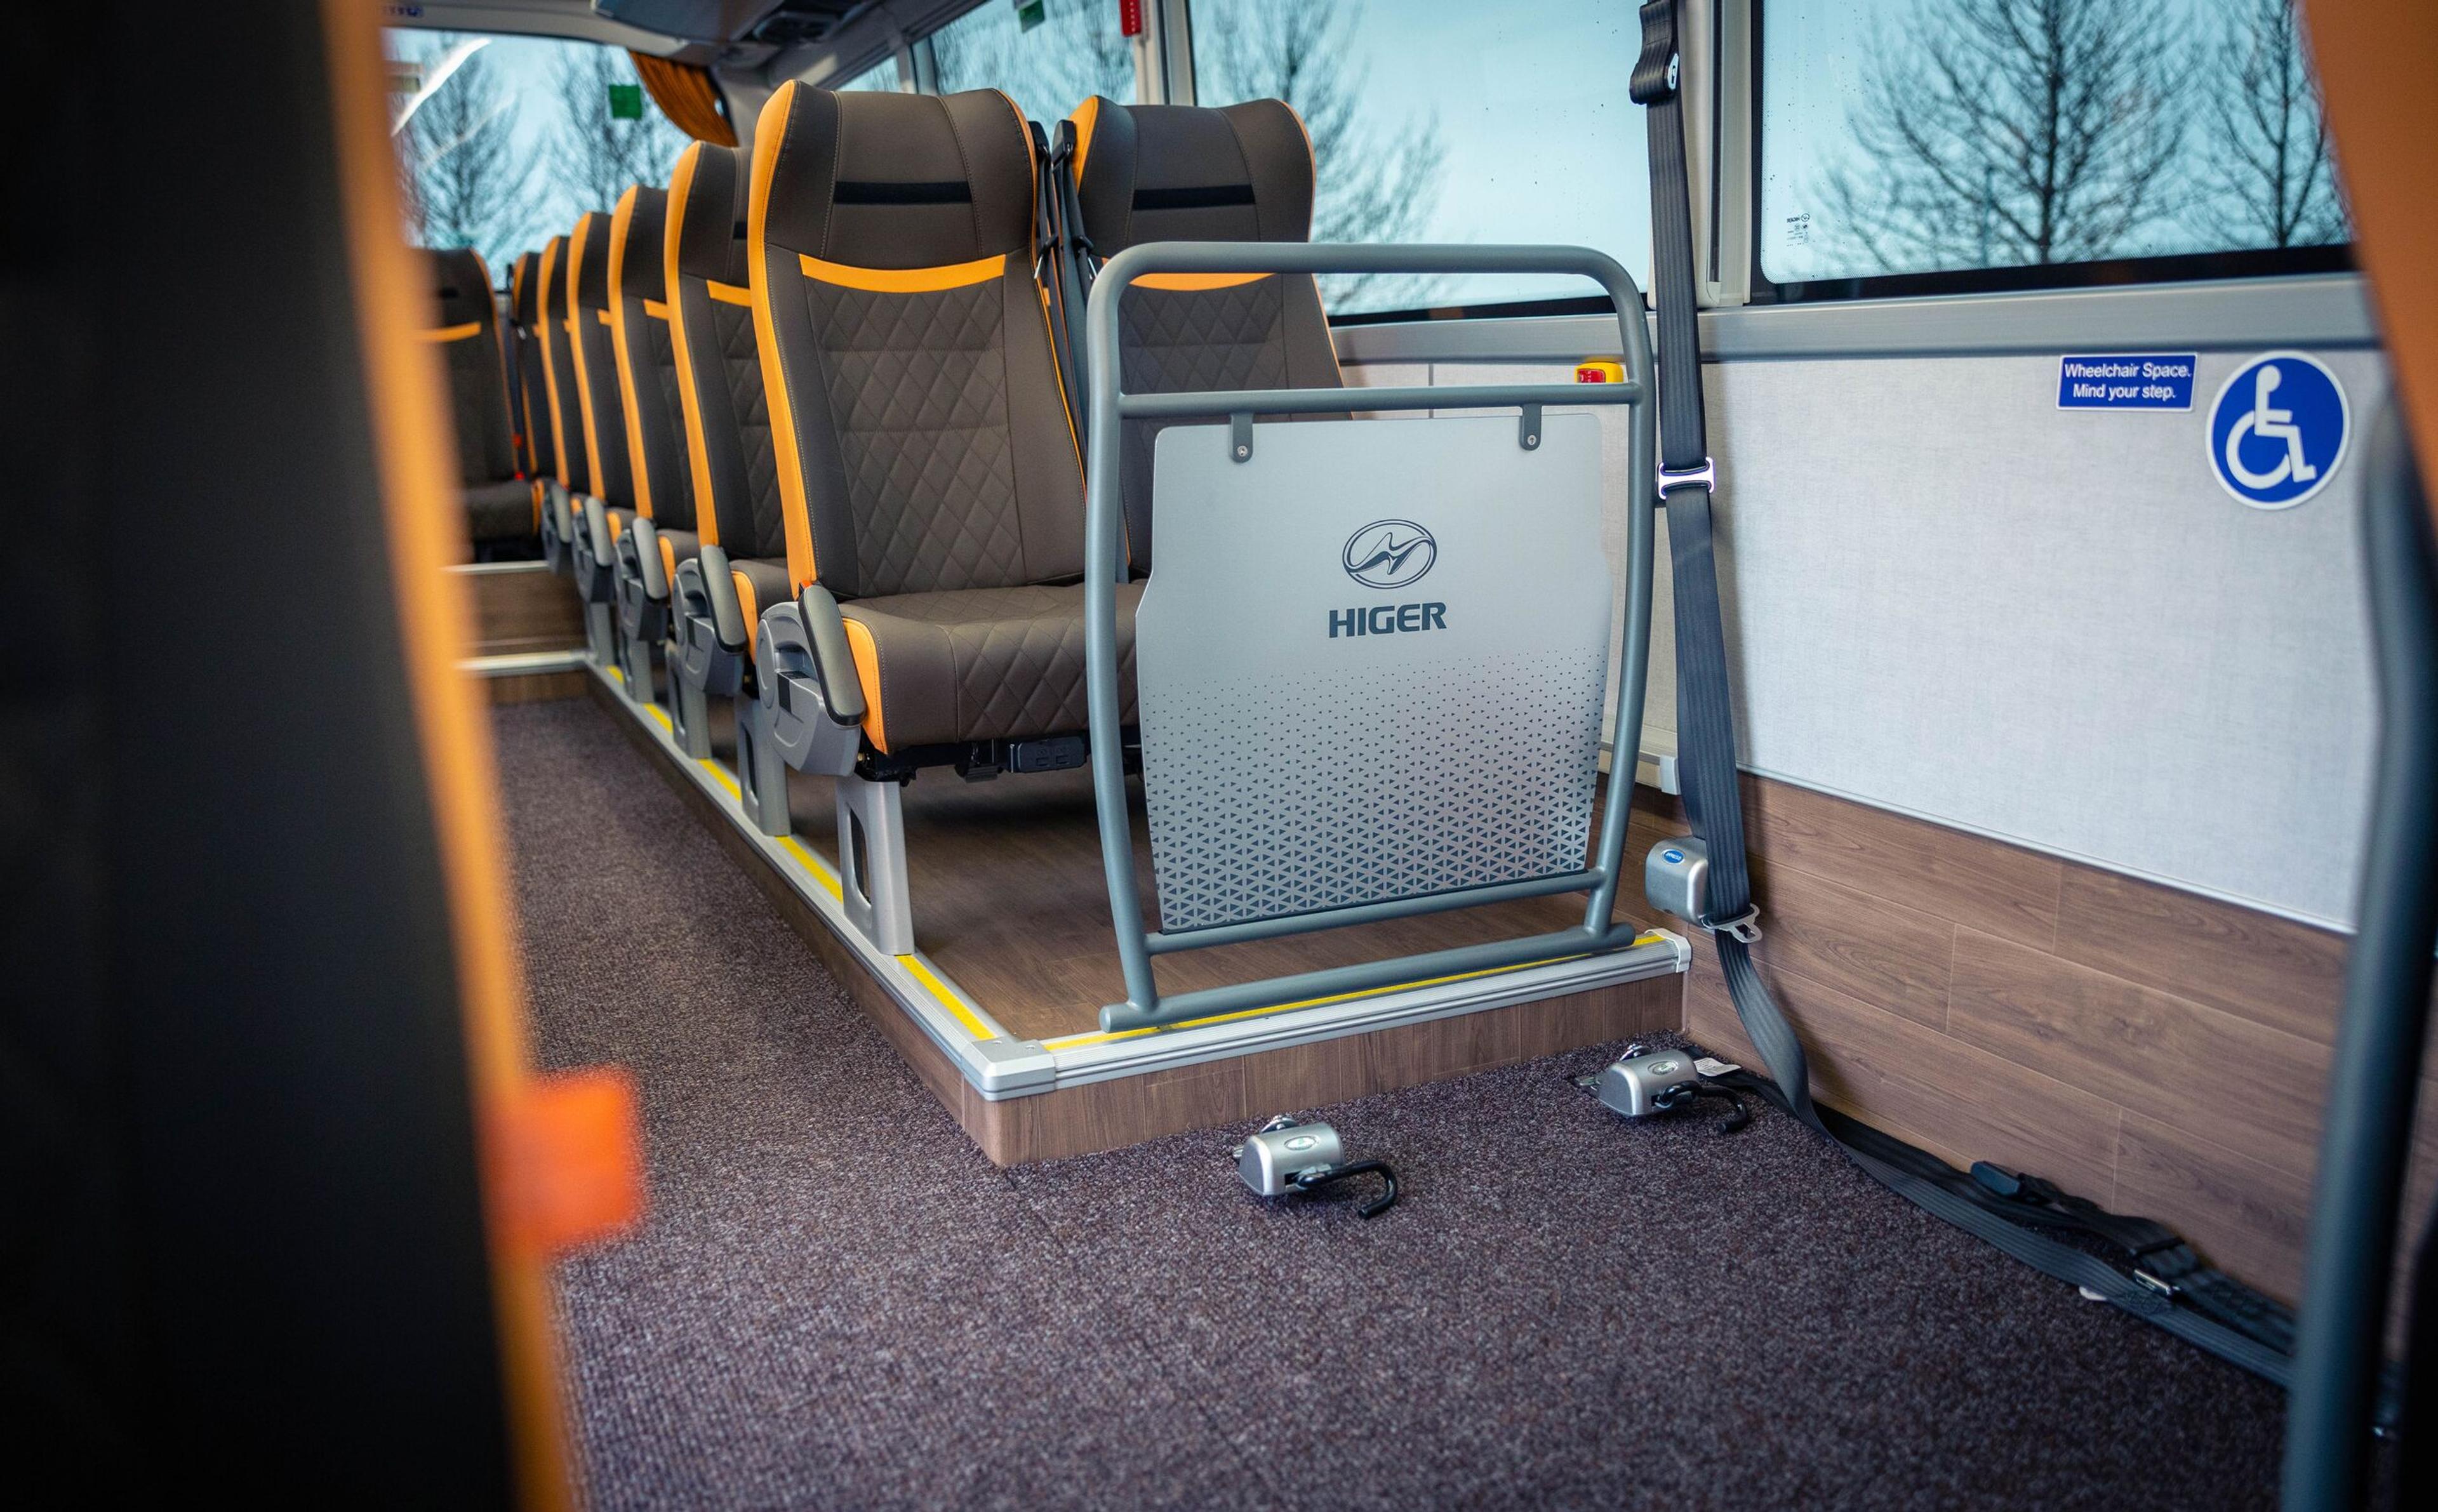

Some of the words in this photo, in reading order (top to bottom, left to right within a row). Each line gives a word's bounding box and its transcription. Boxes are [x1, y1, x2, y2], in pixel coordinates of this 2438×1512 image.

[2064, 363, 2140, 378] Wheelchair
[2142, 362, 2192, 380] Space.
[2073, 383, 2106, 397] Mind
[2108, 386, 2140, 401] your
[2142, 385, 2176, 401] step.
[1329, 602, 1447, 638] HIGER
